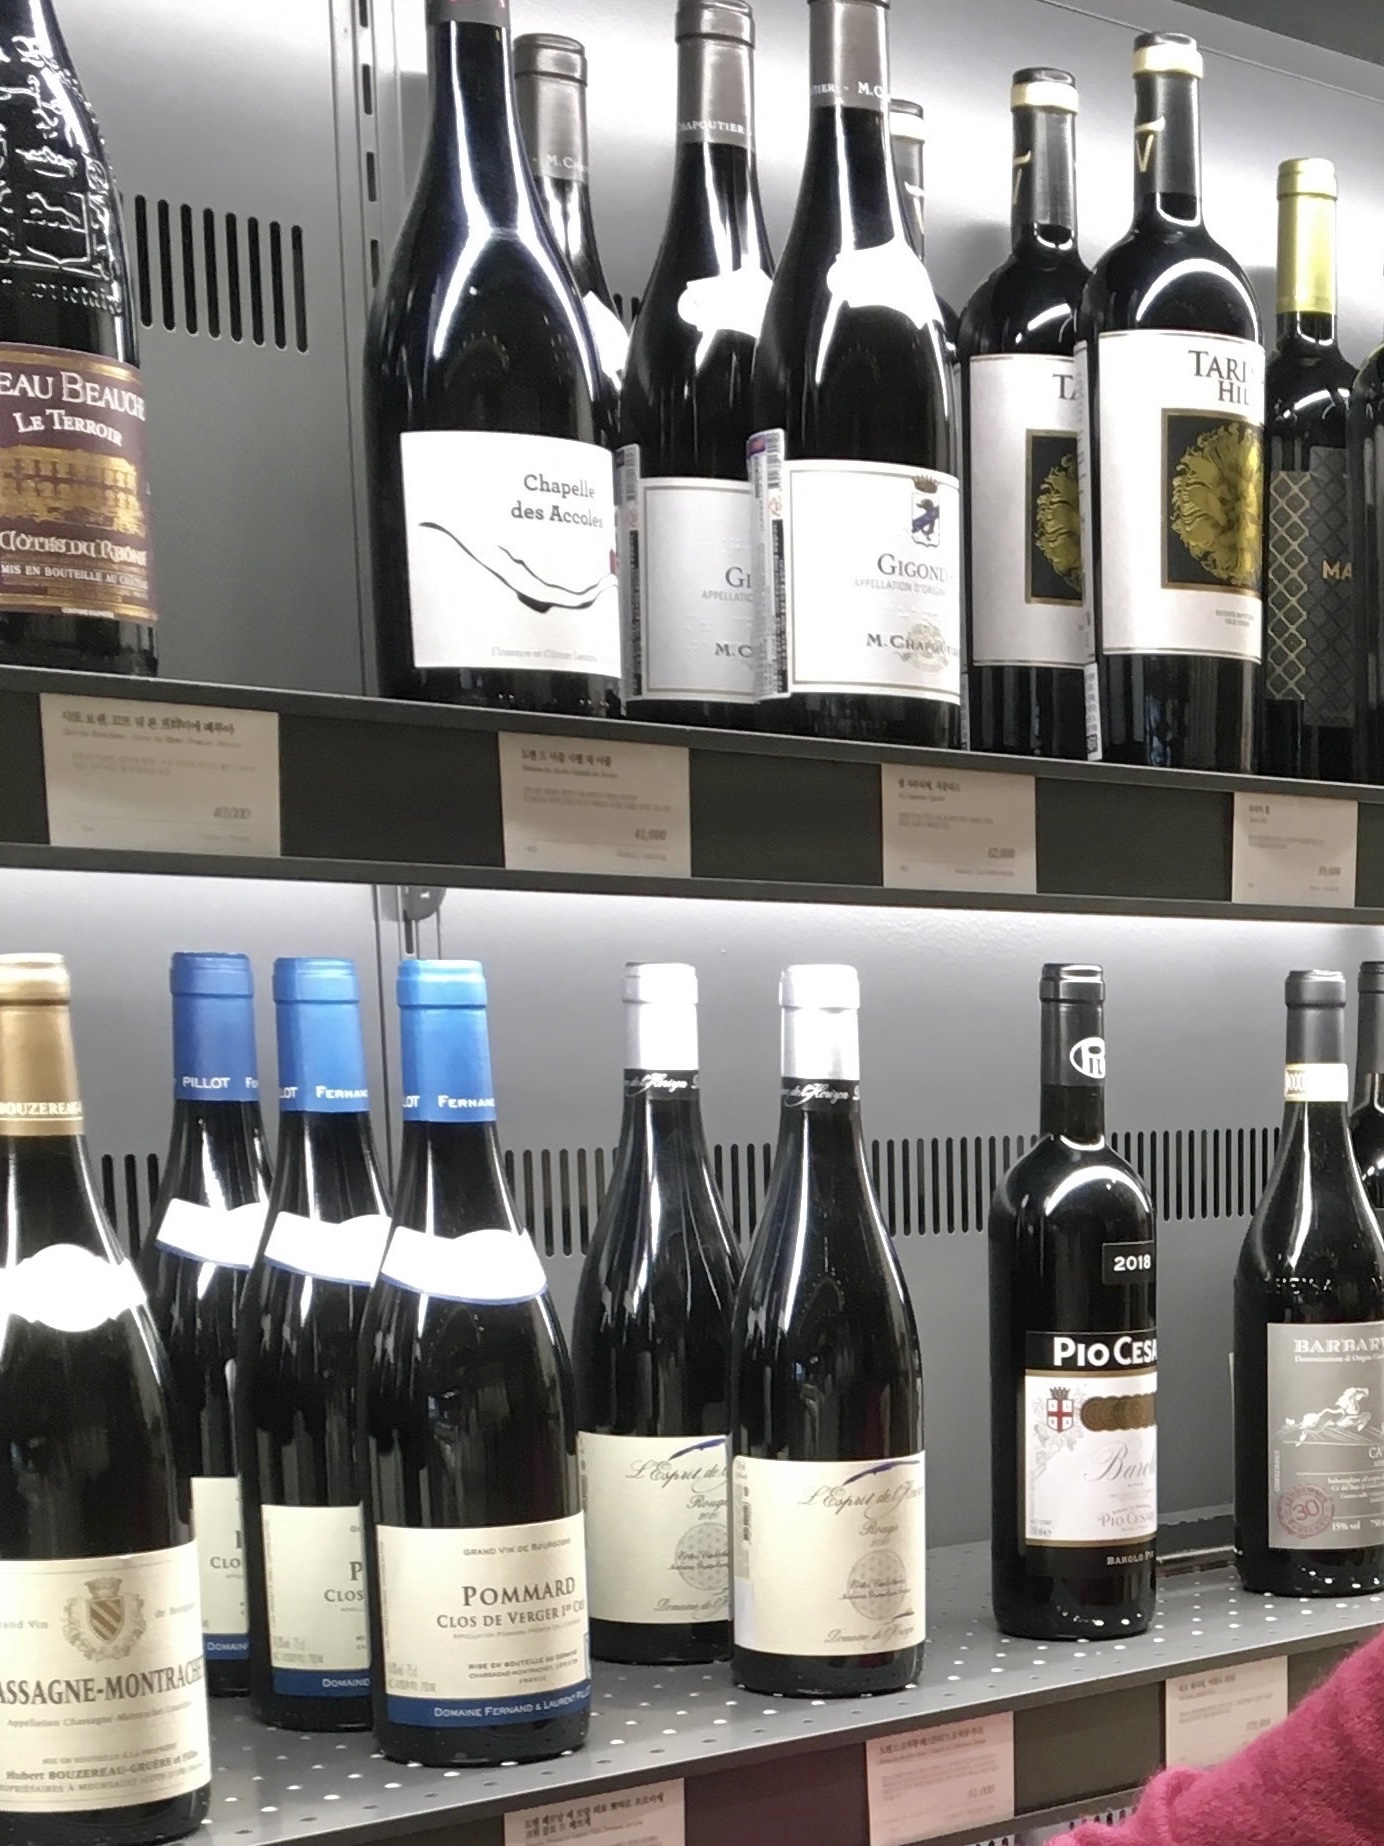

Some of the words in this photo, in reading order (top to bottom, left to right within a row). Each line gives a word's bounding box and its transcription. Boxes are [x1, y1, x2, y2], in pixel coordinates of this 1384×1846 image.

[13, 412, 45, 433] LE
[46, 409, 123, 447] TERROIR
[523, 474, 595, 499] Chapelle
[511, 500, 544, 520] des
[550, 505, 603, 528] Accoles
[1, 564, 21, 575] MIS
[25, 565, 41, 575] EN
[44, 566, 101, 582] BOUTEILLE
[183, 1076, 230, 1089] PILLOT
[1113, 1254, 1151, 1272] 2018
[1053, 1337, 1109, 1367] PIO
[1293, 1500, 1319, 1520] 30
[463, 1547, 496, 1556] GRAND
[210, 1556, 241, 1569] CLO
[324, 1589, 364, 1603] CLOS
[461, 1576, 576, 1607] POMMARD
[436, 1614, 477, 1629] CLOS
[483, 1615, 502, 1627] DE
[506, 1608, 559, 1625] VERGER
[434, 1707, 483, 1718] DOMAINE
[485, 1704, 533, 1717] FERNAND
